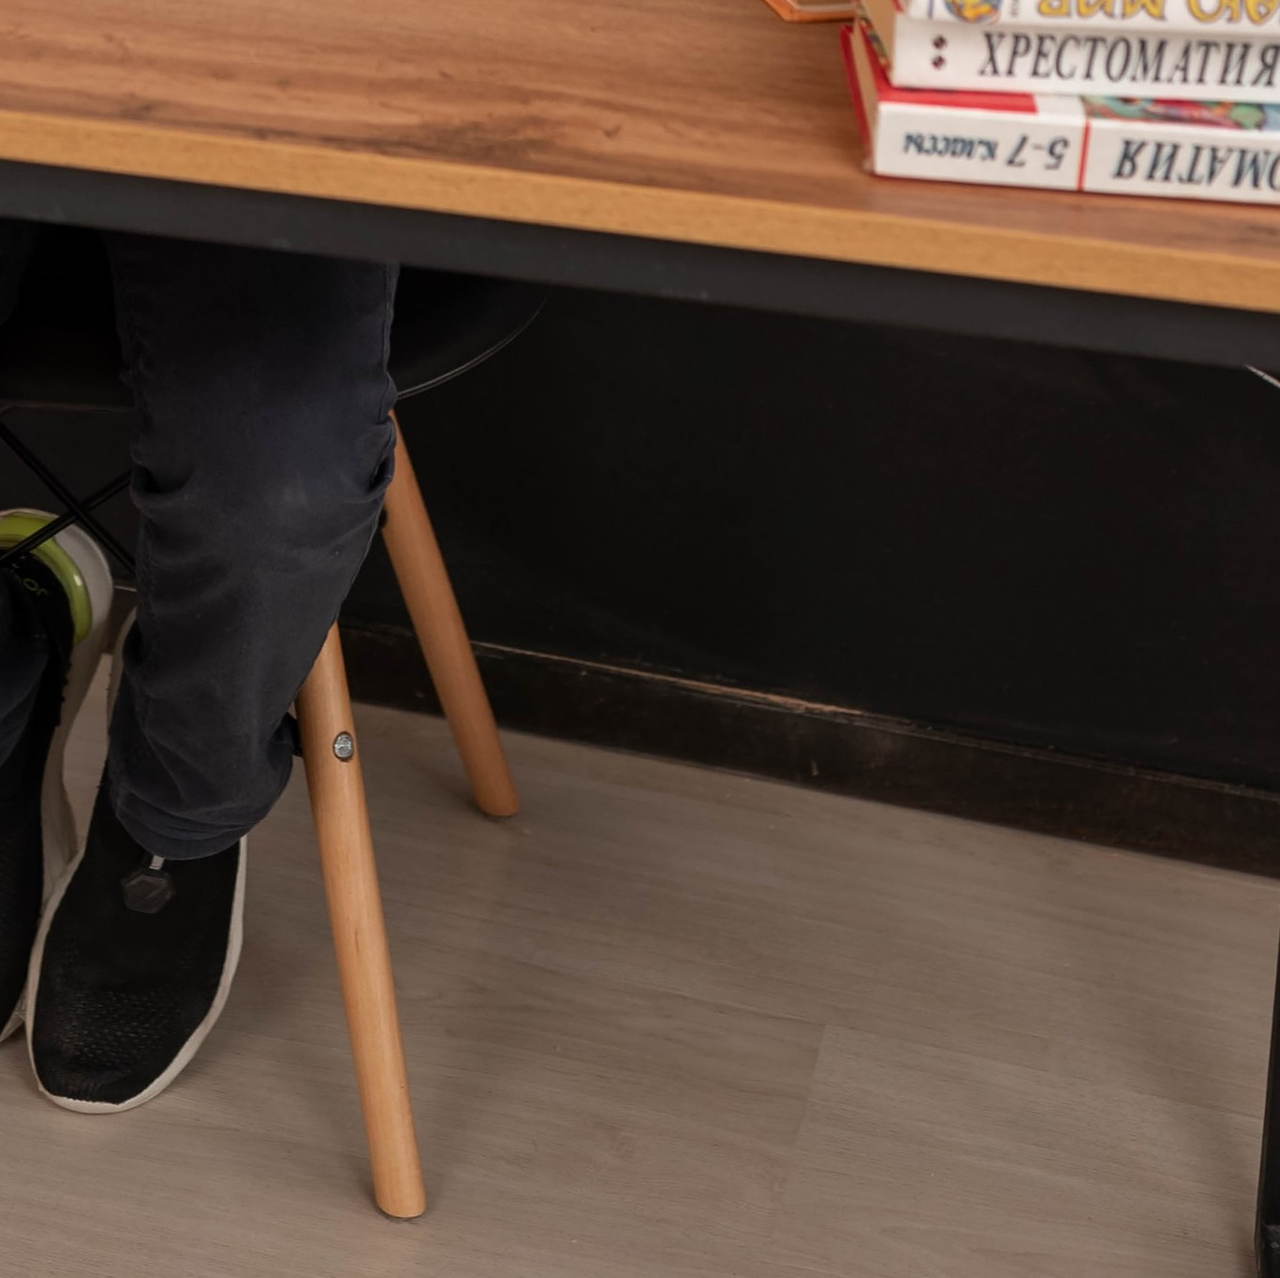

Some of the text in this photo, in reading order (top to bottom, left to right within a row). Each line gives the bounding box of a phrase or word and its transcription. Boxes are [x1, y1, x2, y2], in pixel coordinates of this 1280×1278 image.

[978, 32, 1280, 90] ХРЕСТОМАТИЯ
[902, 132, 997, 162] классы
[1005, 134, 1070, 171] 5-7
